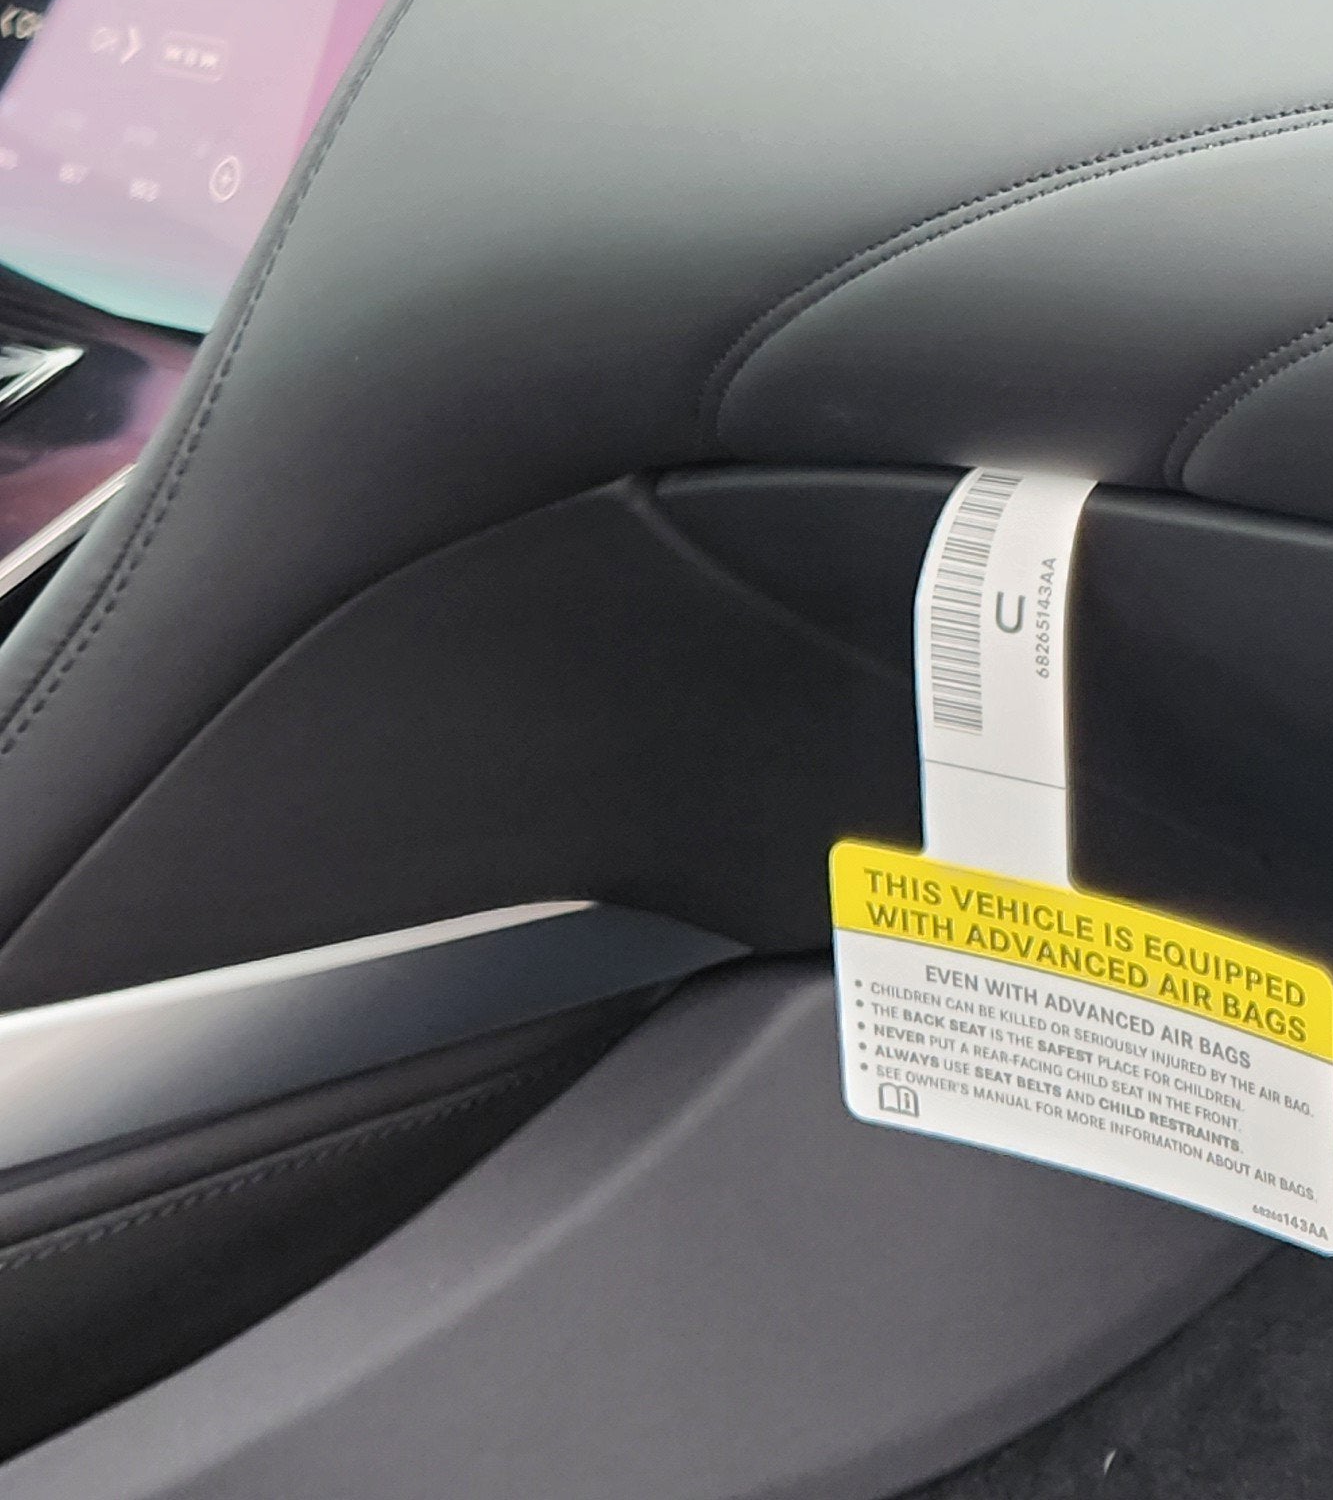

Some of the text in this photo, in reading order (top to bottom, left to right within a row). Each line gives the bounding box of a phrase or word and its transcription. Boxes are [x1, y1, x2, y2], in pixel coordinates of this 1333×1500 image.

[1036, 558, 1056, 679] 68265143AA
[864, 868, 1306, 1008] THIS VEHICLE IS EQUIPPED
[866, 901, 1306, 1042] WITH ADVANCED AIR BAGS
[871, 982, 941, 1007] CHILDREN
[945, 997, 974, 1014] CAN
[979, 1004, 996, 1019] BE
[1000, 1010, 1047, 1031] KILLED
[1051, 1022, 1070, 1037] OR
[1074, 1027, 1147, 1058] SERIOUSLY
[1152, 1050, 1206, 1077] INJURED
[1211, 1070, 1226, 1084] BY
[1230, 1076, 1255, 1095] THE
[1259, 1087, 1280, 1105] AIR
[871, 1002, 898, 1019] THE
[903, 1008, 945, 1028] BACK
[949, 1019, 987, 1038] SEAT
[991, 1027, 1003, 1042] IS
[1007, 1031, 1034, 1049] THE
[1037, 1040, 1093, 1064] SAFEST
[1098, 1054, 1139, 1078] PLACE
[1144, 1068, 1170, 1087] FOR
[874, 1024, 925, 1044] NEVER
[929, 1035, 956, 1052] PUT
[960, 1039, 969, 1054] A
[974, 1044, 1062, 1077] REAR-FACING
[1066, 1067, 1108, 1088] CHILD
[1111, 1080, 1144, 1099] SEAT
[1148, 1090, 1161, 1105] IN
[1166, 1095, 1191, 1114] THE
[926, 965, 1251, 1069] EVEN WITH ADVANCED AIR BAGS
[875, 1045, 939, 1068] ALWAYS
[944, 1058, 970, 1074] USE
[974, 1066, 1012, 1084] SEAT
[1016, 1075, 1062, 1097] BELTS
[1065, 1087, 1095, 1106] AND
[1099, 1095, 1145, 1120] CHILD
[876, 1065, 901, 1080] SEE
[906, 1070, 969, 1095] OWNER'S
[974, 1085, 1031, 1111] MANUAL
[1036, 1101, 1062, 1118] FOR
[1067, 1108, 1105, 1130] MORE
[1110, 1121, 1202, 1160] INFORMATION
[1207, 1153, 1250, 1177] ABOUT
[1254, 1168, 1276, 1186] AIR
